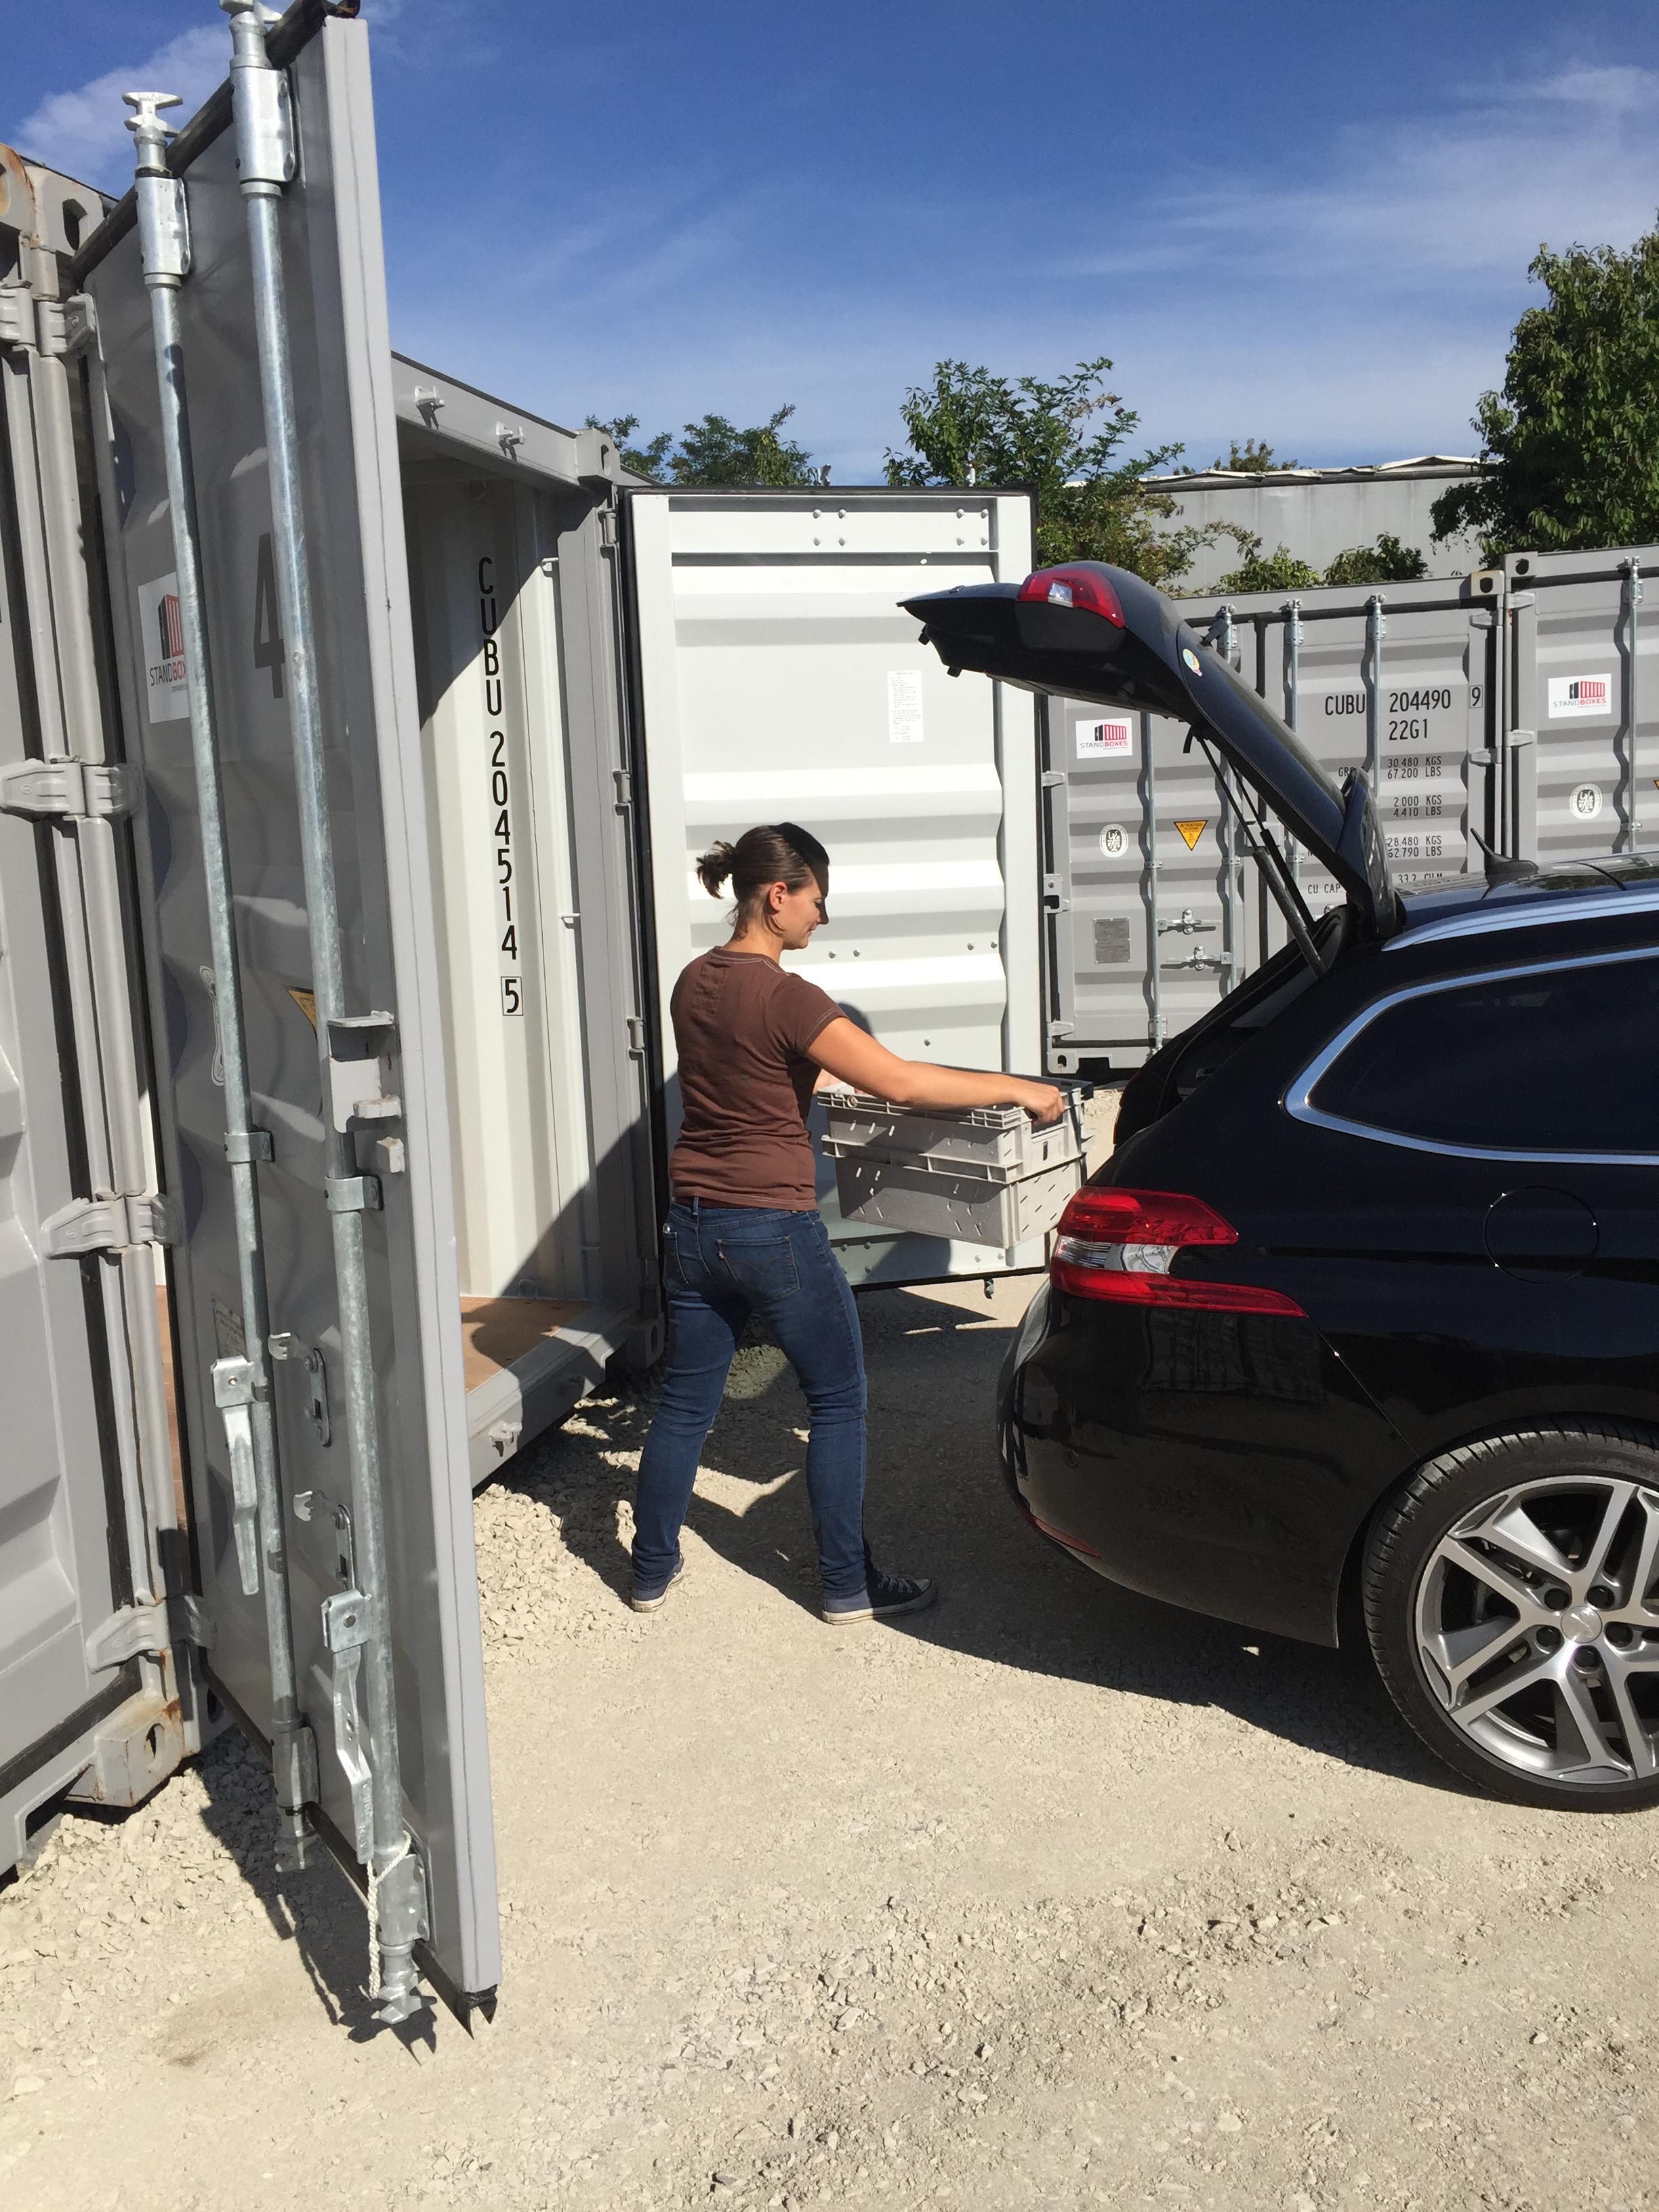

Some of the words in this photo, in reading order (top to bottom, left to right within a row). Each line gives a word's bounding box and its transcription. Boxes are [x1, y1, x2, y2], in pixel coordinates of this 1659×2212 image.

[253, 532, 285, 699] 4
[478, 556, 502, 716] CUBU
[149, 660, 187, 686] STANDBOX
[1325, 693, 1366, 716] CUBU
[1389, 689, 1451, 712] 204490
[1471, 687, 1481, 707] 9
[1553, 697, 1607, 708] STANDBOXES
[1389, 718, 1428, 740] 22G1
[1387, 757, 1419, 769] 30.480
[1425, 756, 1442, 766] KGS
[1387, 768, 1419, 779] 67.200
[1425, 766, 1441, 777] LBS
[1394, 796, 1419, 807] 2.000
[1426, 794, 1442, 805] KGS
[1393, 806, 1419, 817] 4.410
[1425, 806, 1441, 816] LBS
[489, 731, 518, 960] 204514
[1387, 836, 1419, 847] 28.480
[1425, 835, 1442, 845] KGS
[1425, 846, 1442, 857] LBS
[505, 979, 519, 1014] 5
